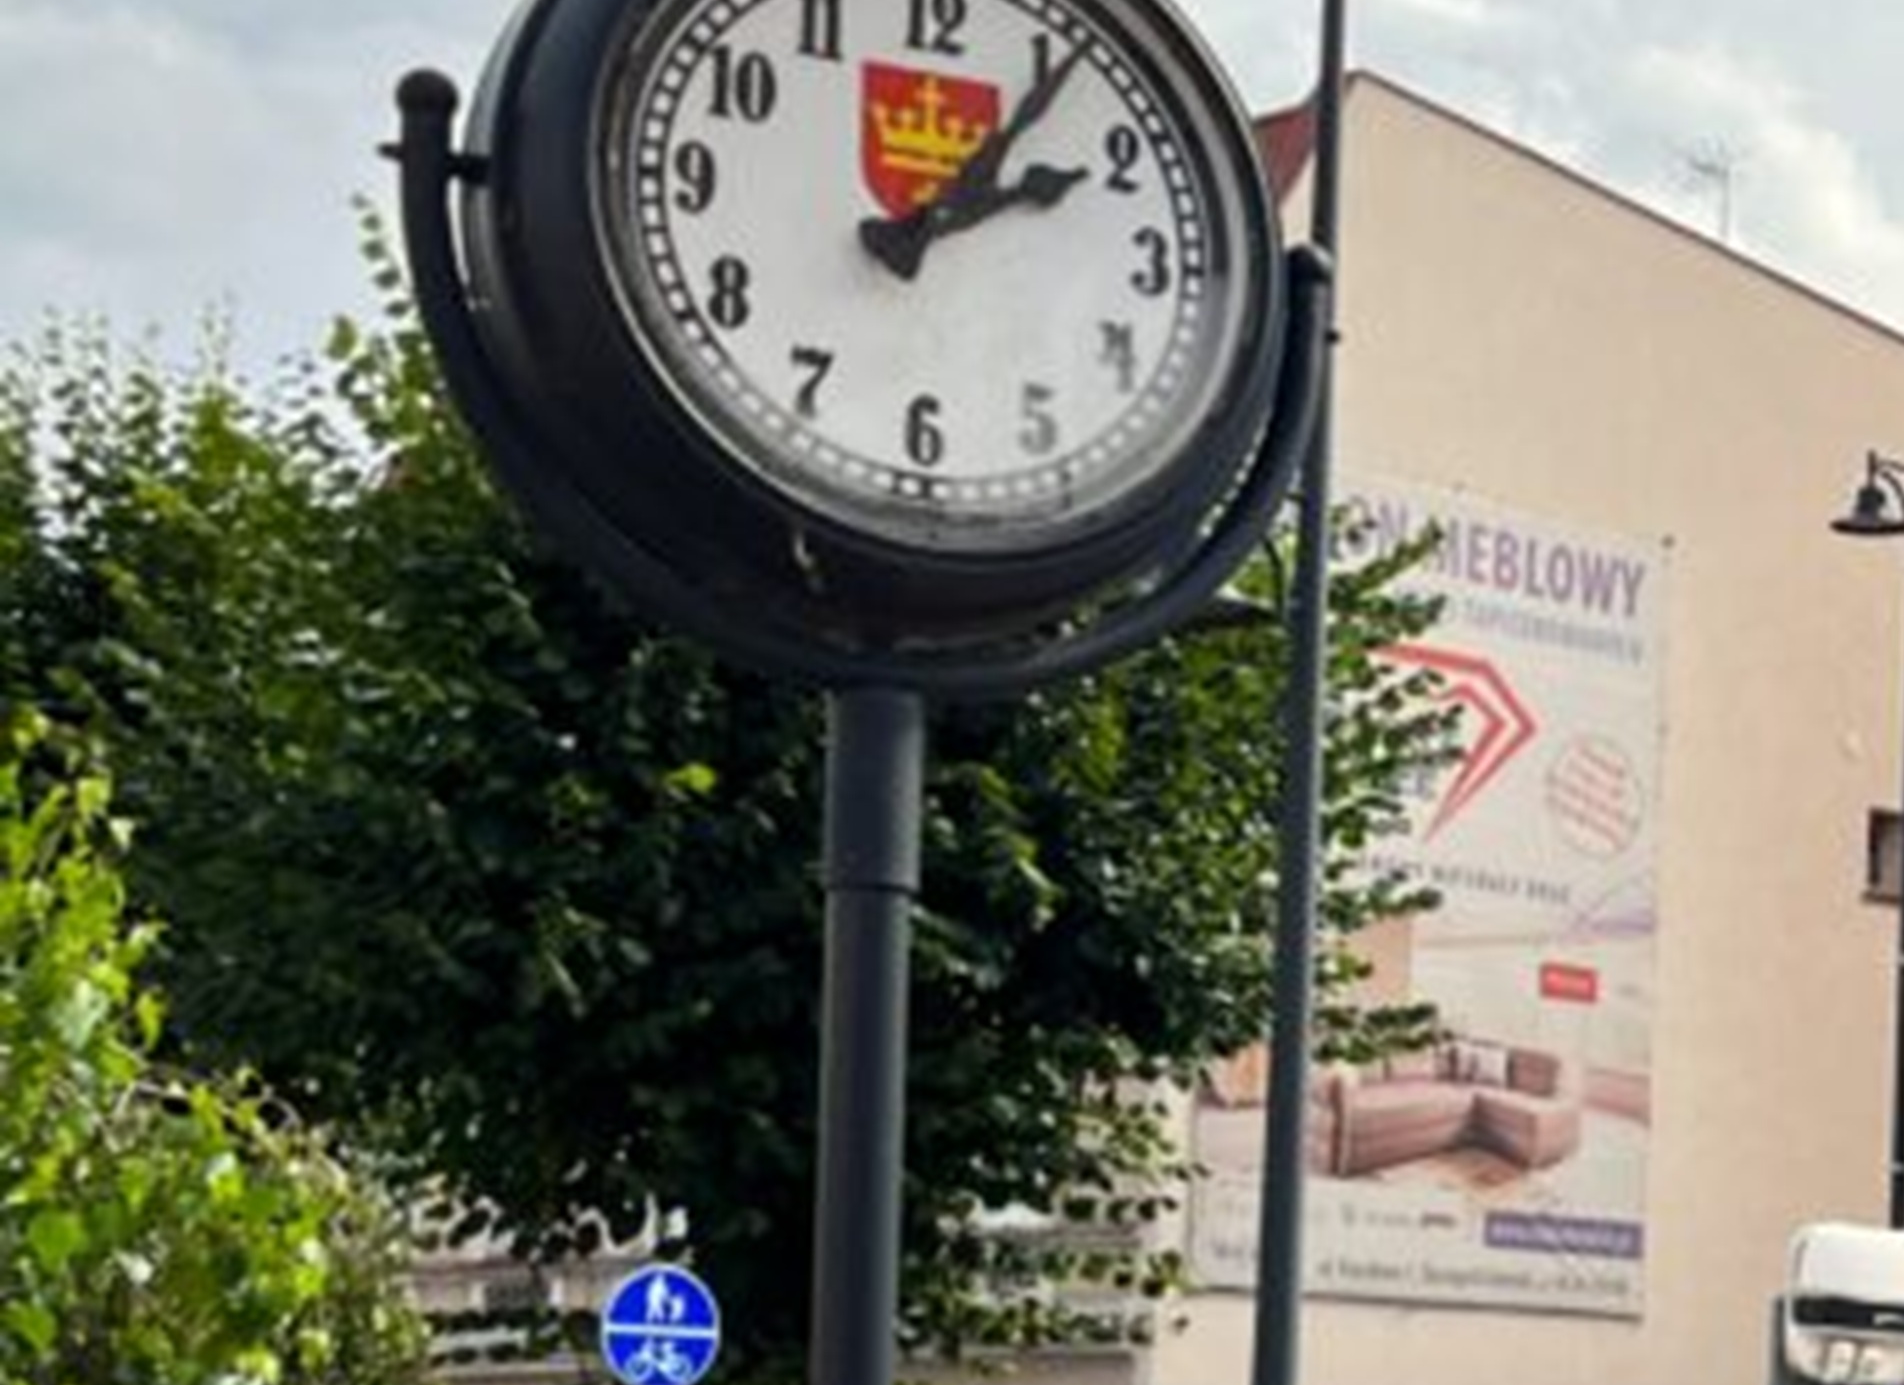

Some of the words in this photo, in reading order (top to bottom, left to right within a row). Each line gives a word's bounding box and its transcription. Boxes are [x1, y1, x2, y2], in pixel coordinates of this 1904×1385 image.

[707, 44, 777, 121] 10
[673, 140, 716, 214] 9
[1105, 124, 1140, 195] 2
[707, 256, 751, 329] 8
[1130, 226, 1170, 297] 3
[790, 345, 833, 420] 7
[1018, 382, 1057, 455] 5
[905, 394, 943, 466] 6
